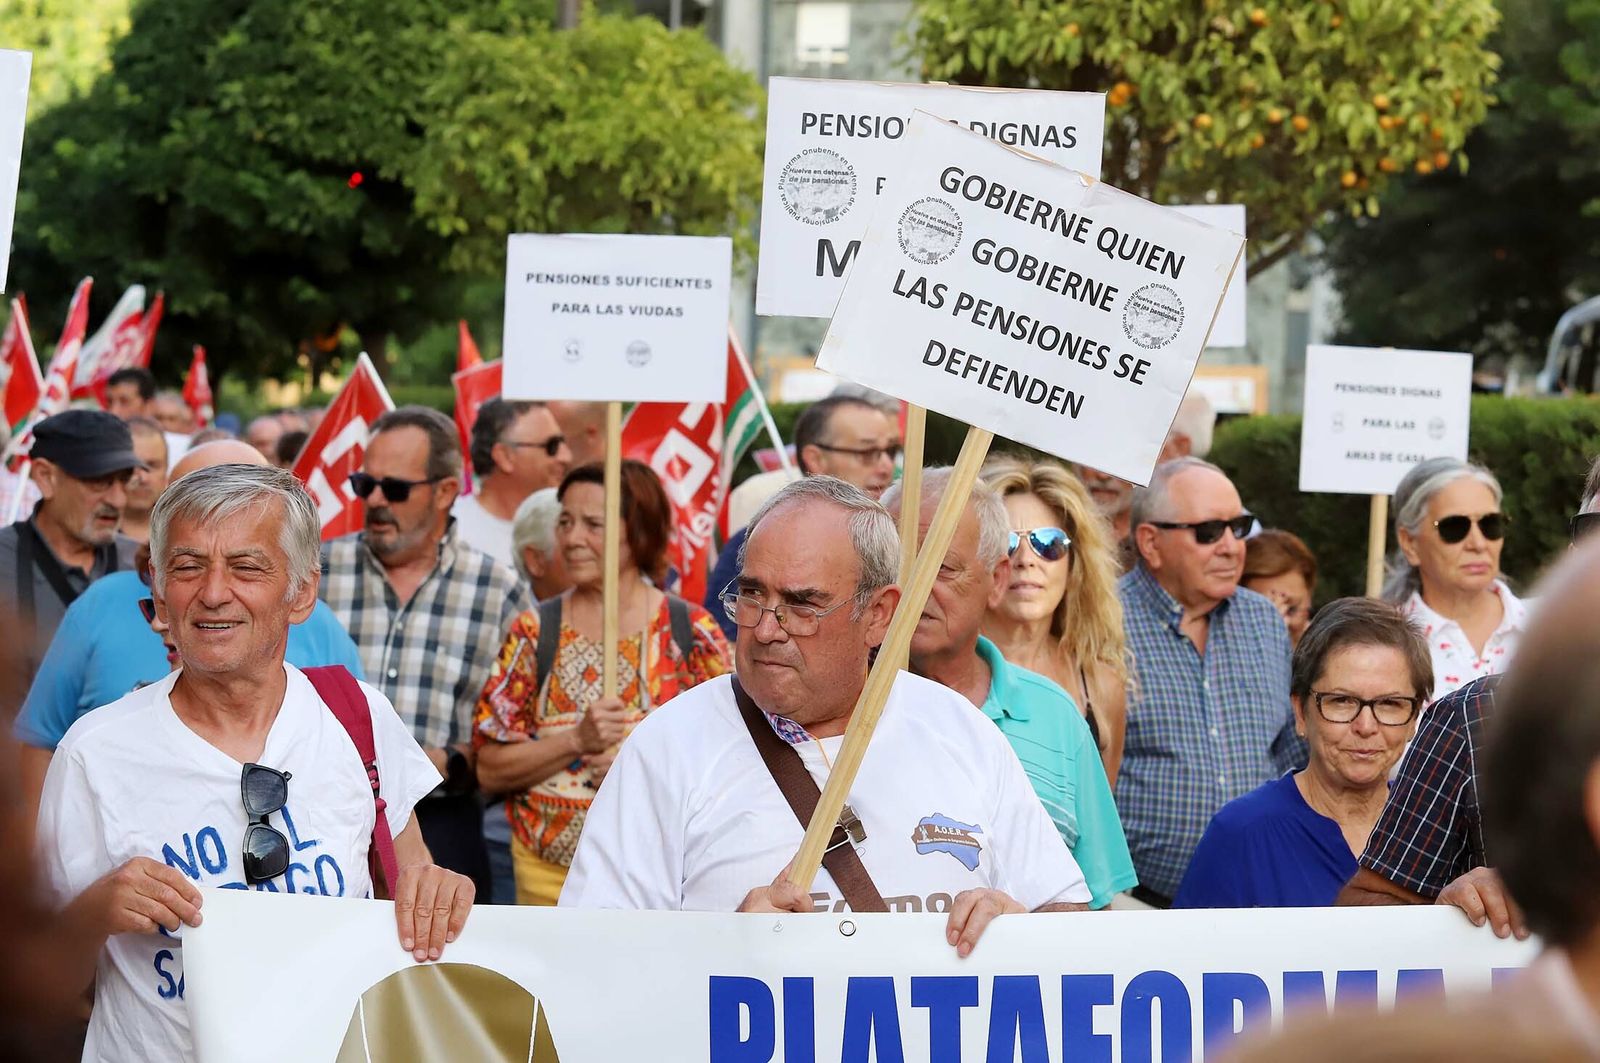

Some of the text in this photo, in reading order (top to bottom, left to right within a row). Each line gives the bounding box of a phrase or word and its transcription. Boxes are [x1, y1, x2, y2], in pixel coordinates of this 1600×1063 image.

[778, 154, 801, 190] Plataforma
[802, 147, 840, 158] Onubense
[847, 165, 857, 195] Defensa
[898, 198, 925, 225] Plataforma
[926, 196, 955, 212] Onubense
[954, 221, 963, 248] Defensa
[940, 166, 1185, 280] GOBIERNE QUIEN
[526, 272, 713, 290] PENSIONES SUFICIENTES
[971, 238, 1118, 313] GOBIERNE
[552, 302, 684, 317] PARA LAS VIUDAS
[892, 269, 1151, 385] LAS PENSIONES SE
[1123, 285, 1148, 311] Plataforma
[1150, 283, 1177, 297] Onubense
[1176, 306, 1184, 333] Defensa
[922, 339, 1085, 419] DEFIENDEN
[1334, 383, 1442, 398] PENSIONES DIGNAS
[1362, 418, 1391, 429] PARA
[1395, 420, 1416, 430] LAS
[1380, 452, 1393, 462] DE
[162, 825, 228, 880] NO
[934, 825, 965, 836] A.O.E.R.
[709, 969, 1447, 1063] PLATAFOR
